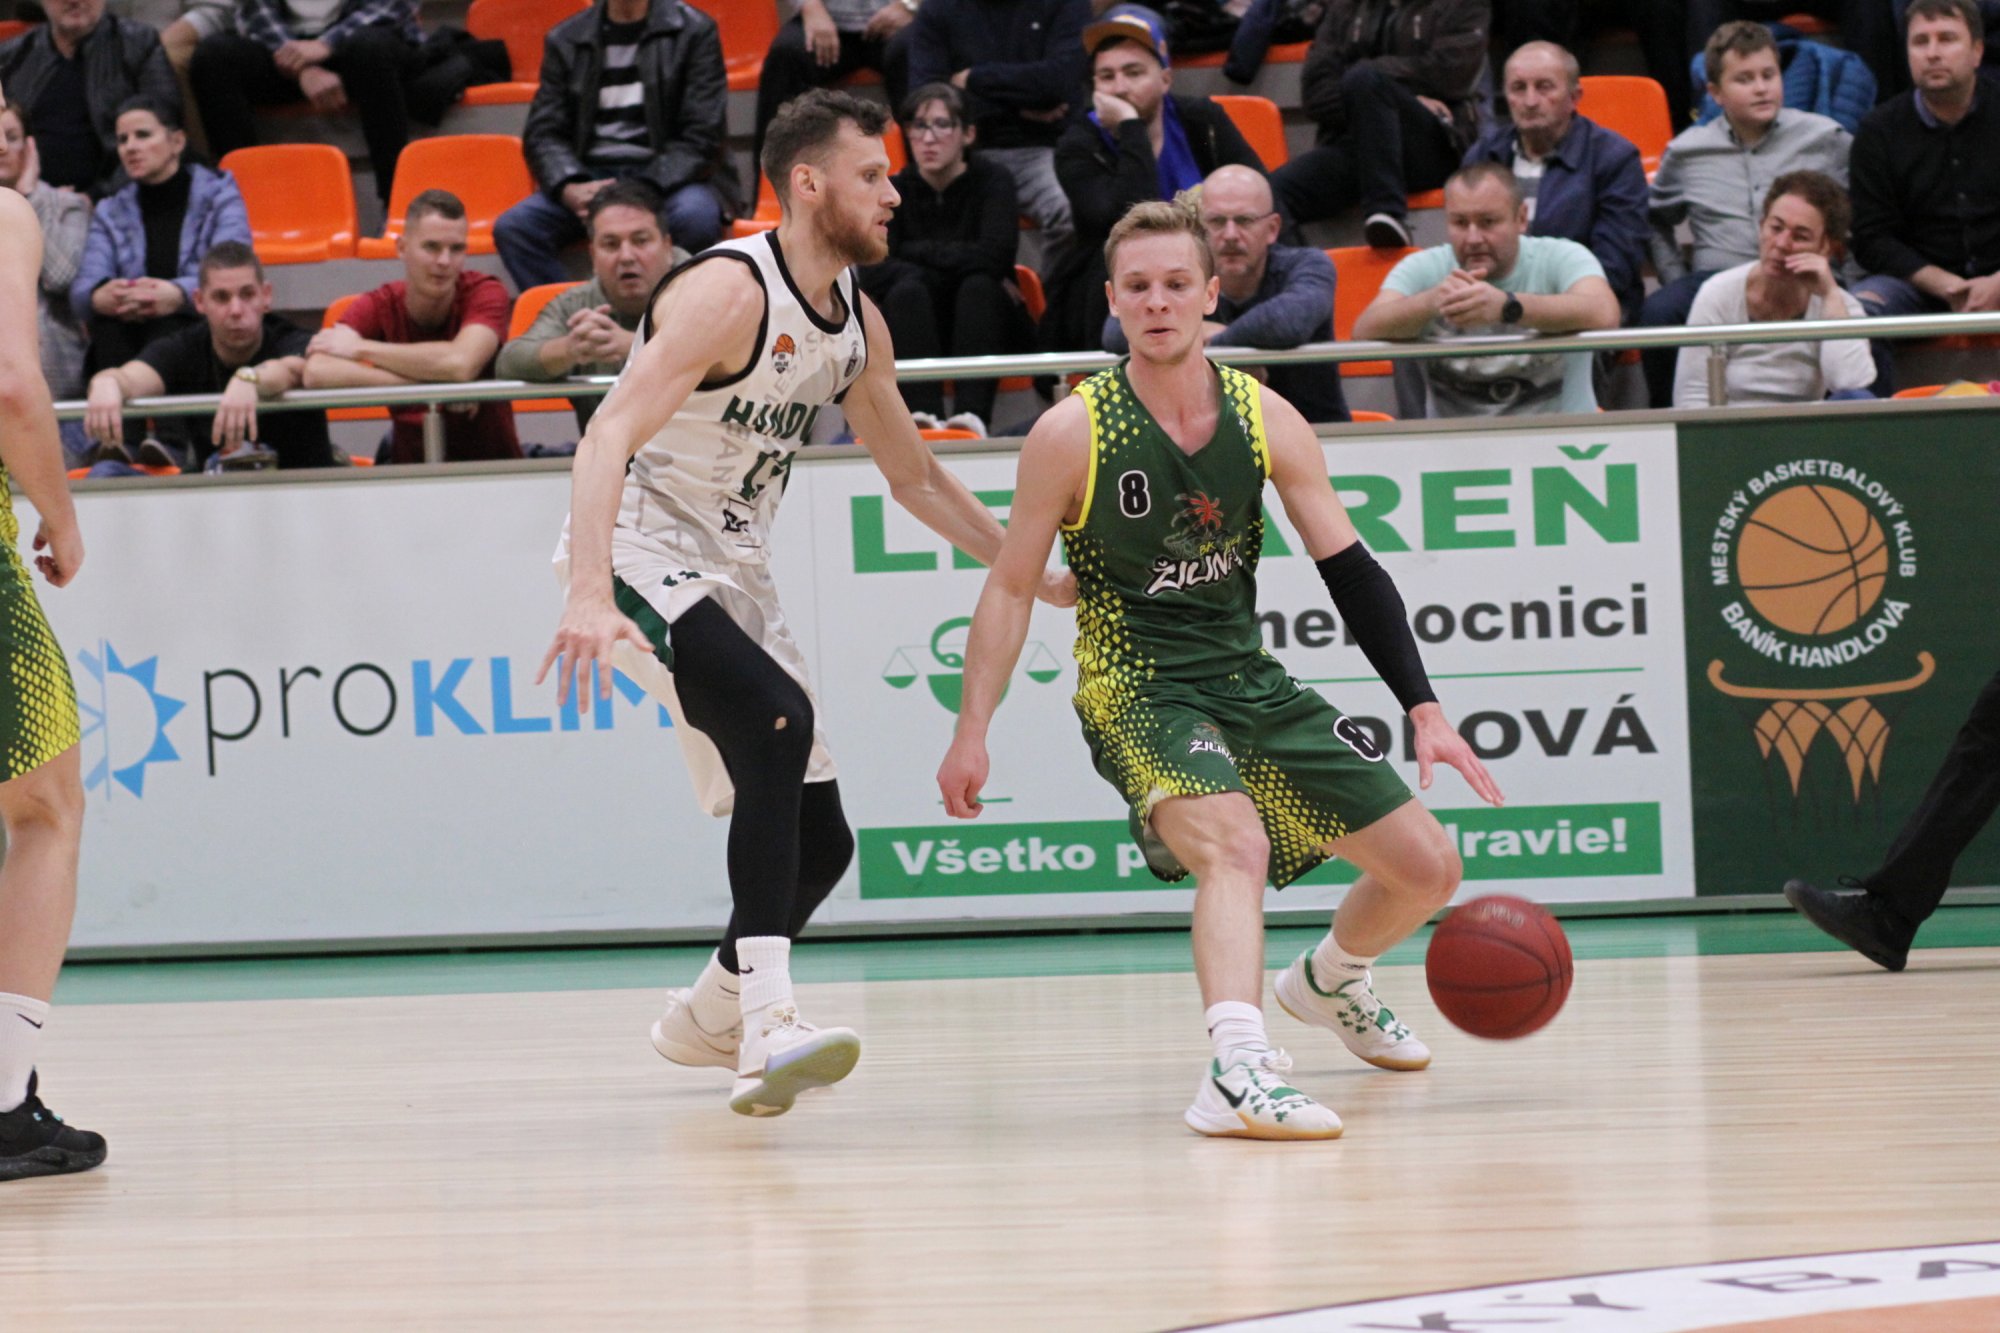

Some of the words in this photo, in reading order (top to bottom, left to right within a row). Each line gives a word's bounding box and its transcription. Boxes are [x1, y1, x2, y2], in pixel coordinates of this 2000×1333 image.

[851, 444, 1641, 574] LREŇ
[1118, 470, 1151, 518] 8
[1711, 490, 1750, 586] MESTSKÝ
[1747, 459, 1904, 518] BASKETBALOVÝ
[1892, 520, 1917, 577] KLUB
[1256, 583, 1647, 650] neocnici
[1721, 601, 1788, 662] BANÍK
[1788, 598, 1911, 668] HANDLOVÁ
[1332, 715, 1384, 763] 8
[891, 837, 1096, 876] Všetko
